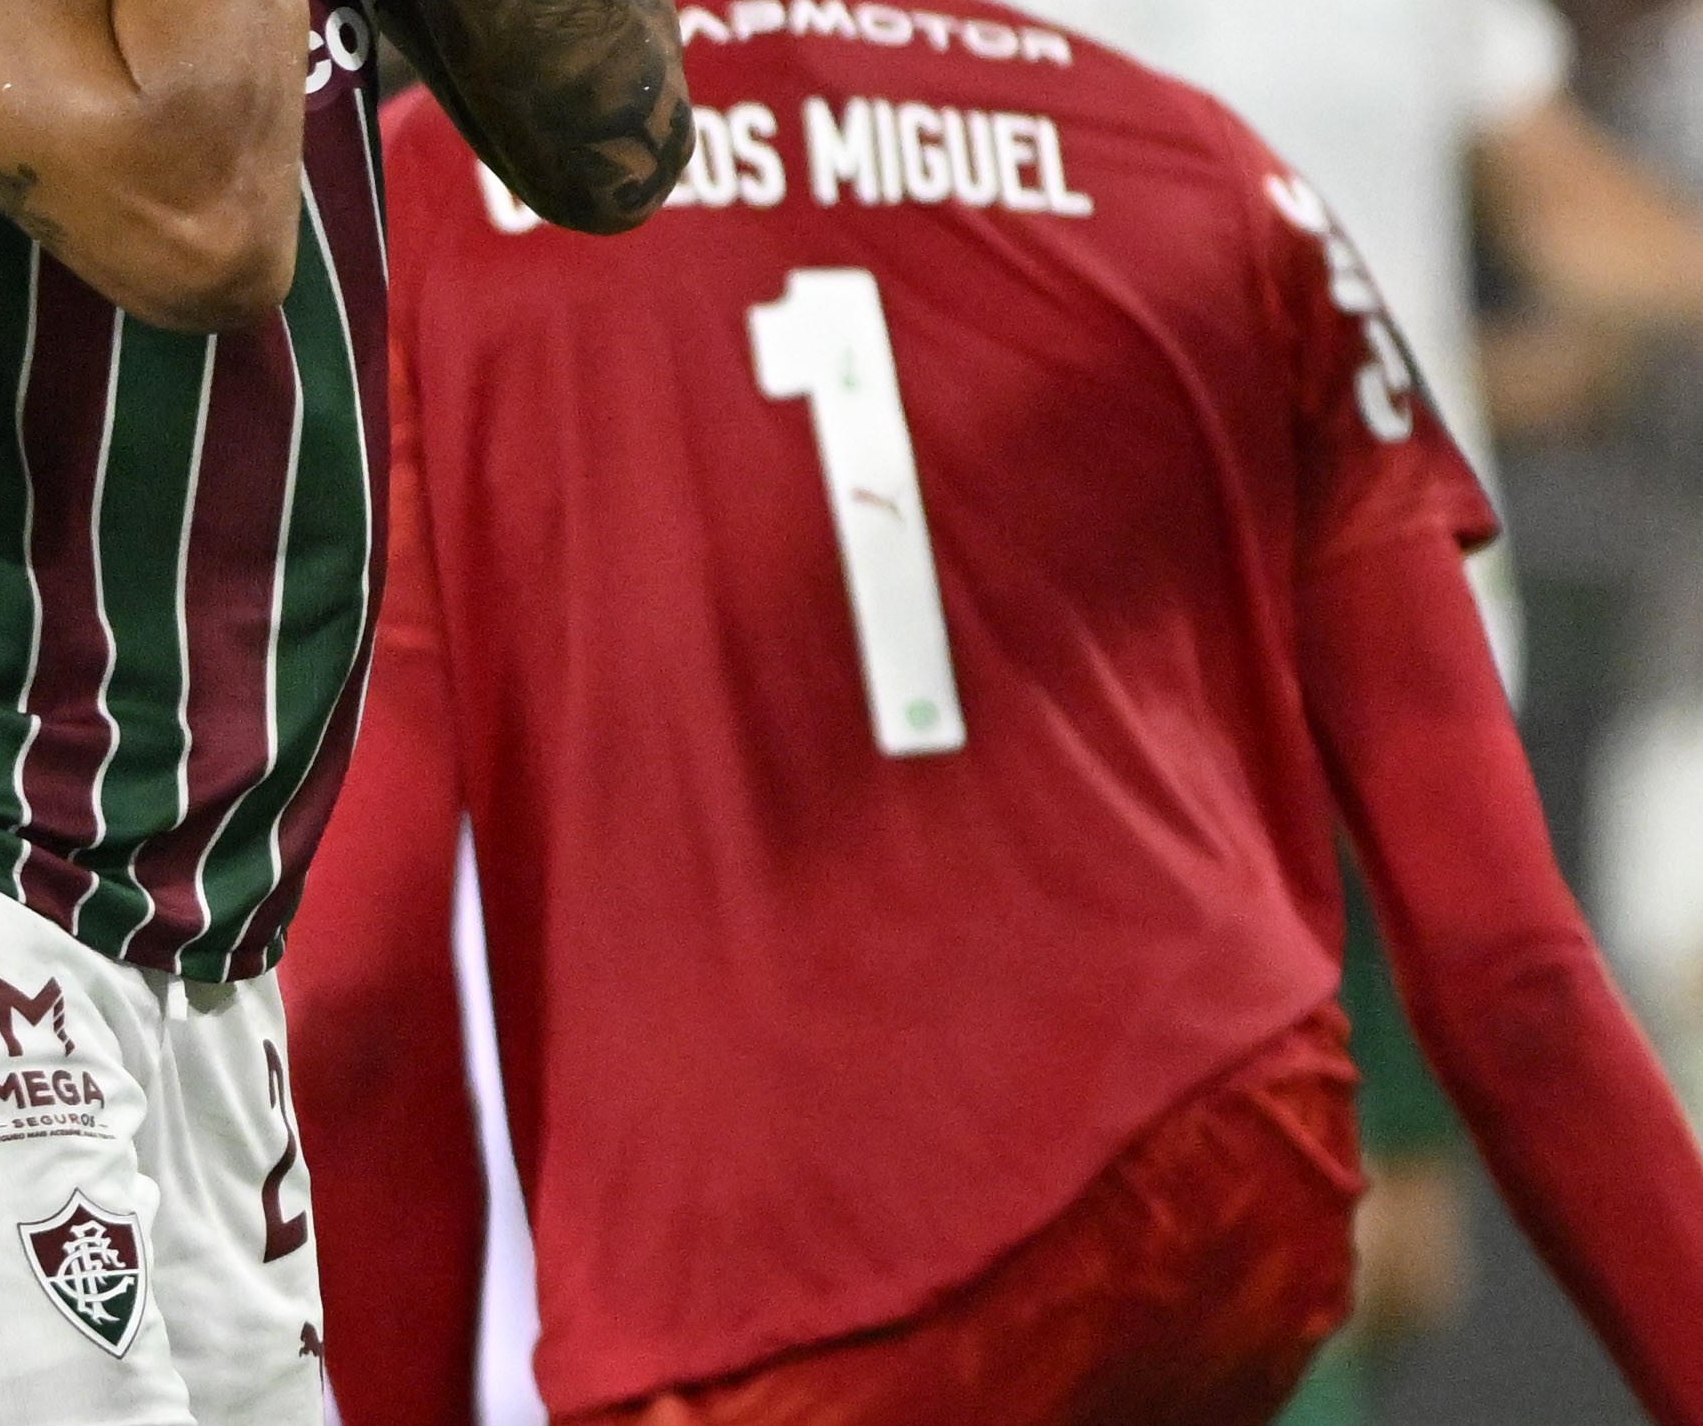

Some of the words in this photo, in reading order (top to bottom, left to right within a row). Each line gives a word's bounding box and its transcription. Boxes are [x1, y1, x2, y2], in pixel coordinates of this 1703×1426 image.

[803, 96, 1094, 216] MIGUEL
[747, 268, 966, 758] 1
[11, 1113, 96, 1129] SEGUROS
